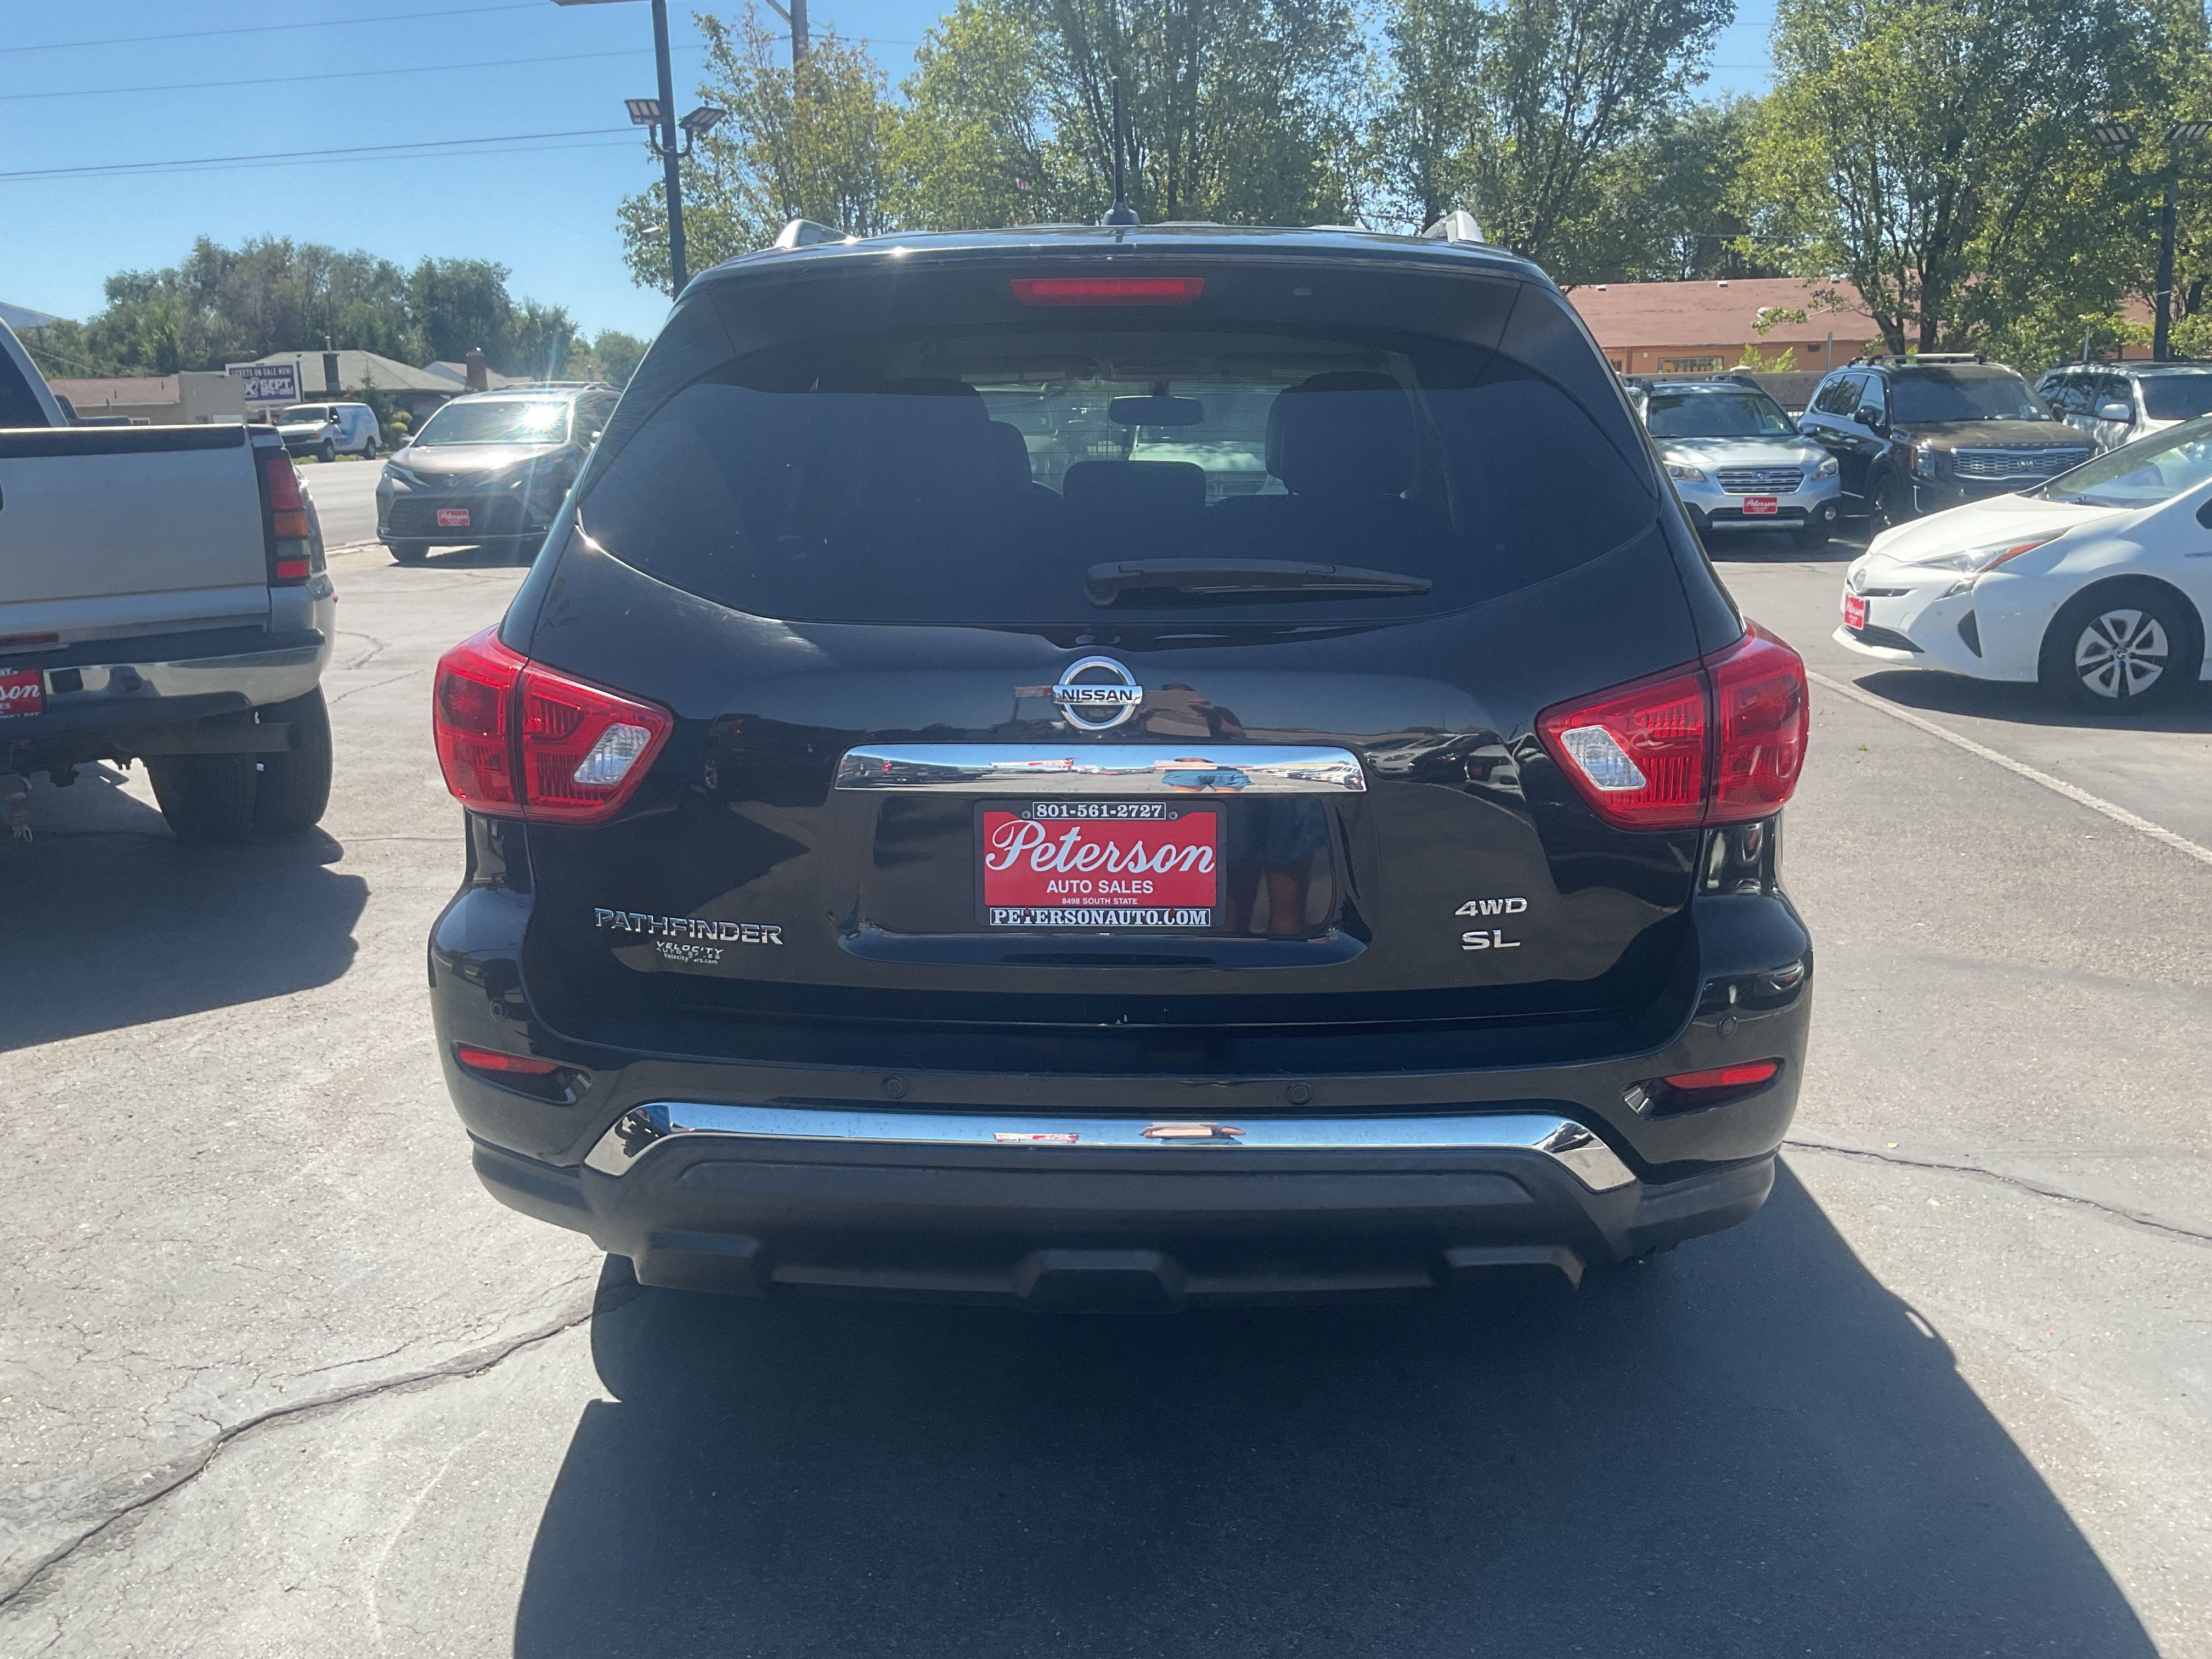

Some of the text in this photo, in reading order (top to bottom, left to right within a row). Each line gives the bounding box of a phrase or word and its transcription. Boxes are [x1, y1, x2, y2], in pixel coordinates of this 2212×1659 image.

[1062, 689, 1132, 701] NISSAN
[1036, 804, 1162, 817] 801-561-2727
[985, 820, 1214, 873] Peterson
[1047, 880, 1153, 894] AUTO SALES
[1455, 897, 1527, 916] 4WD
[994, 909, 1207, 926] PETERSONAUTO.COM
[595, 908, 783, 945] PATHFINDER
[1462, 929, 1521, 950] SL
[663, 952, 718, 964] Velocityars.com
[688, 951, 720, 960] SES
